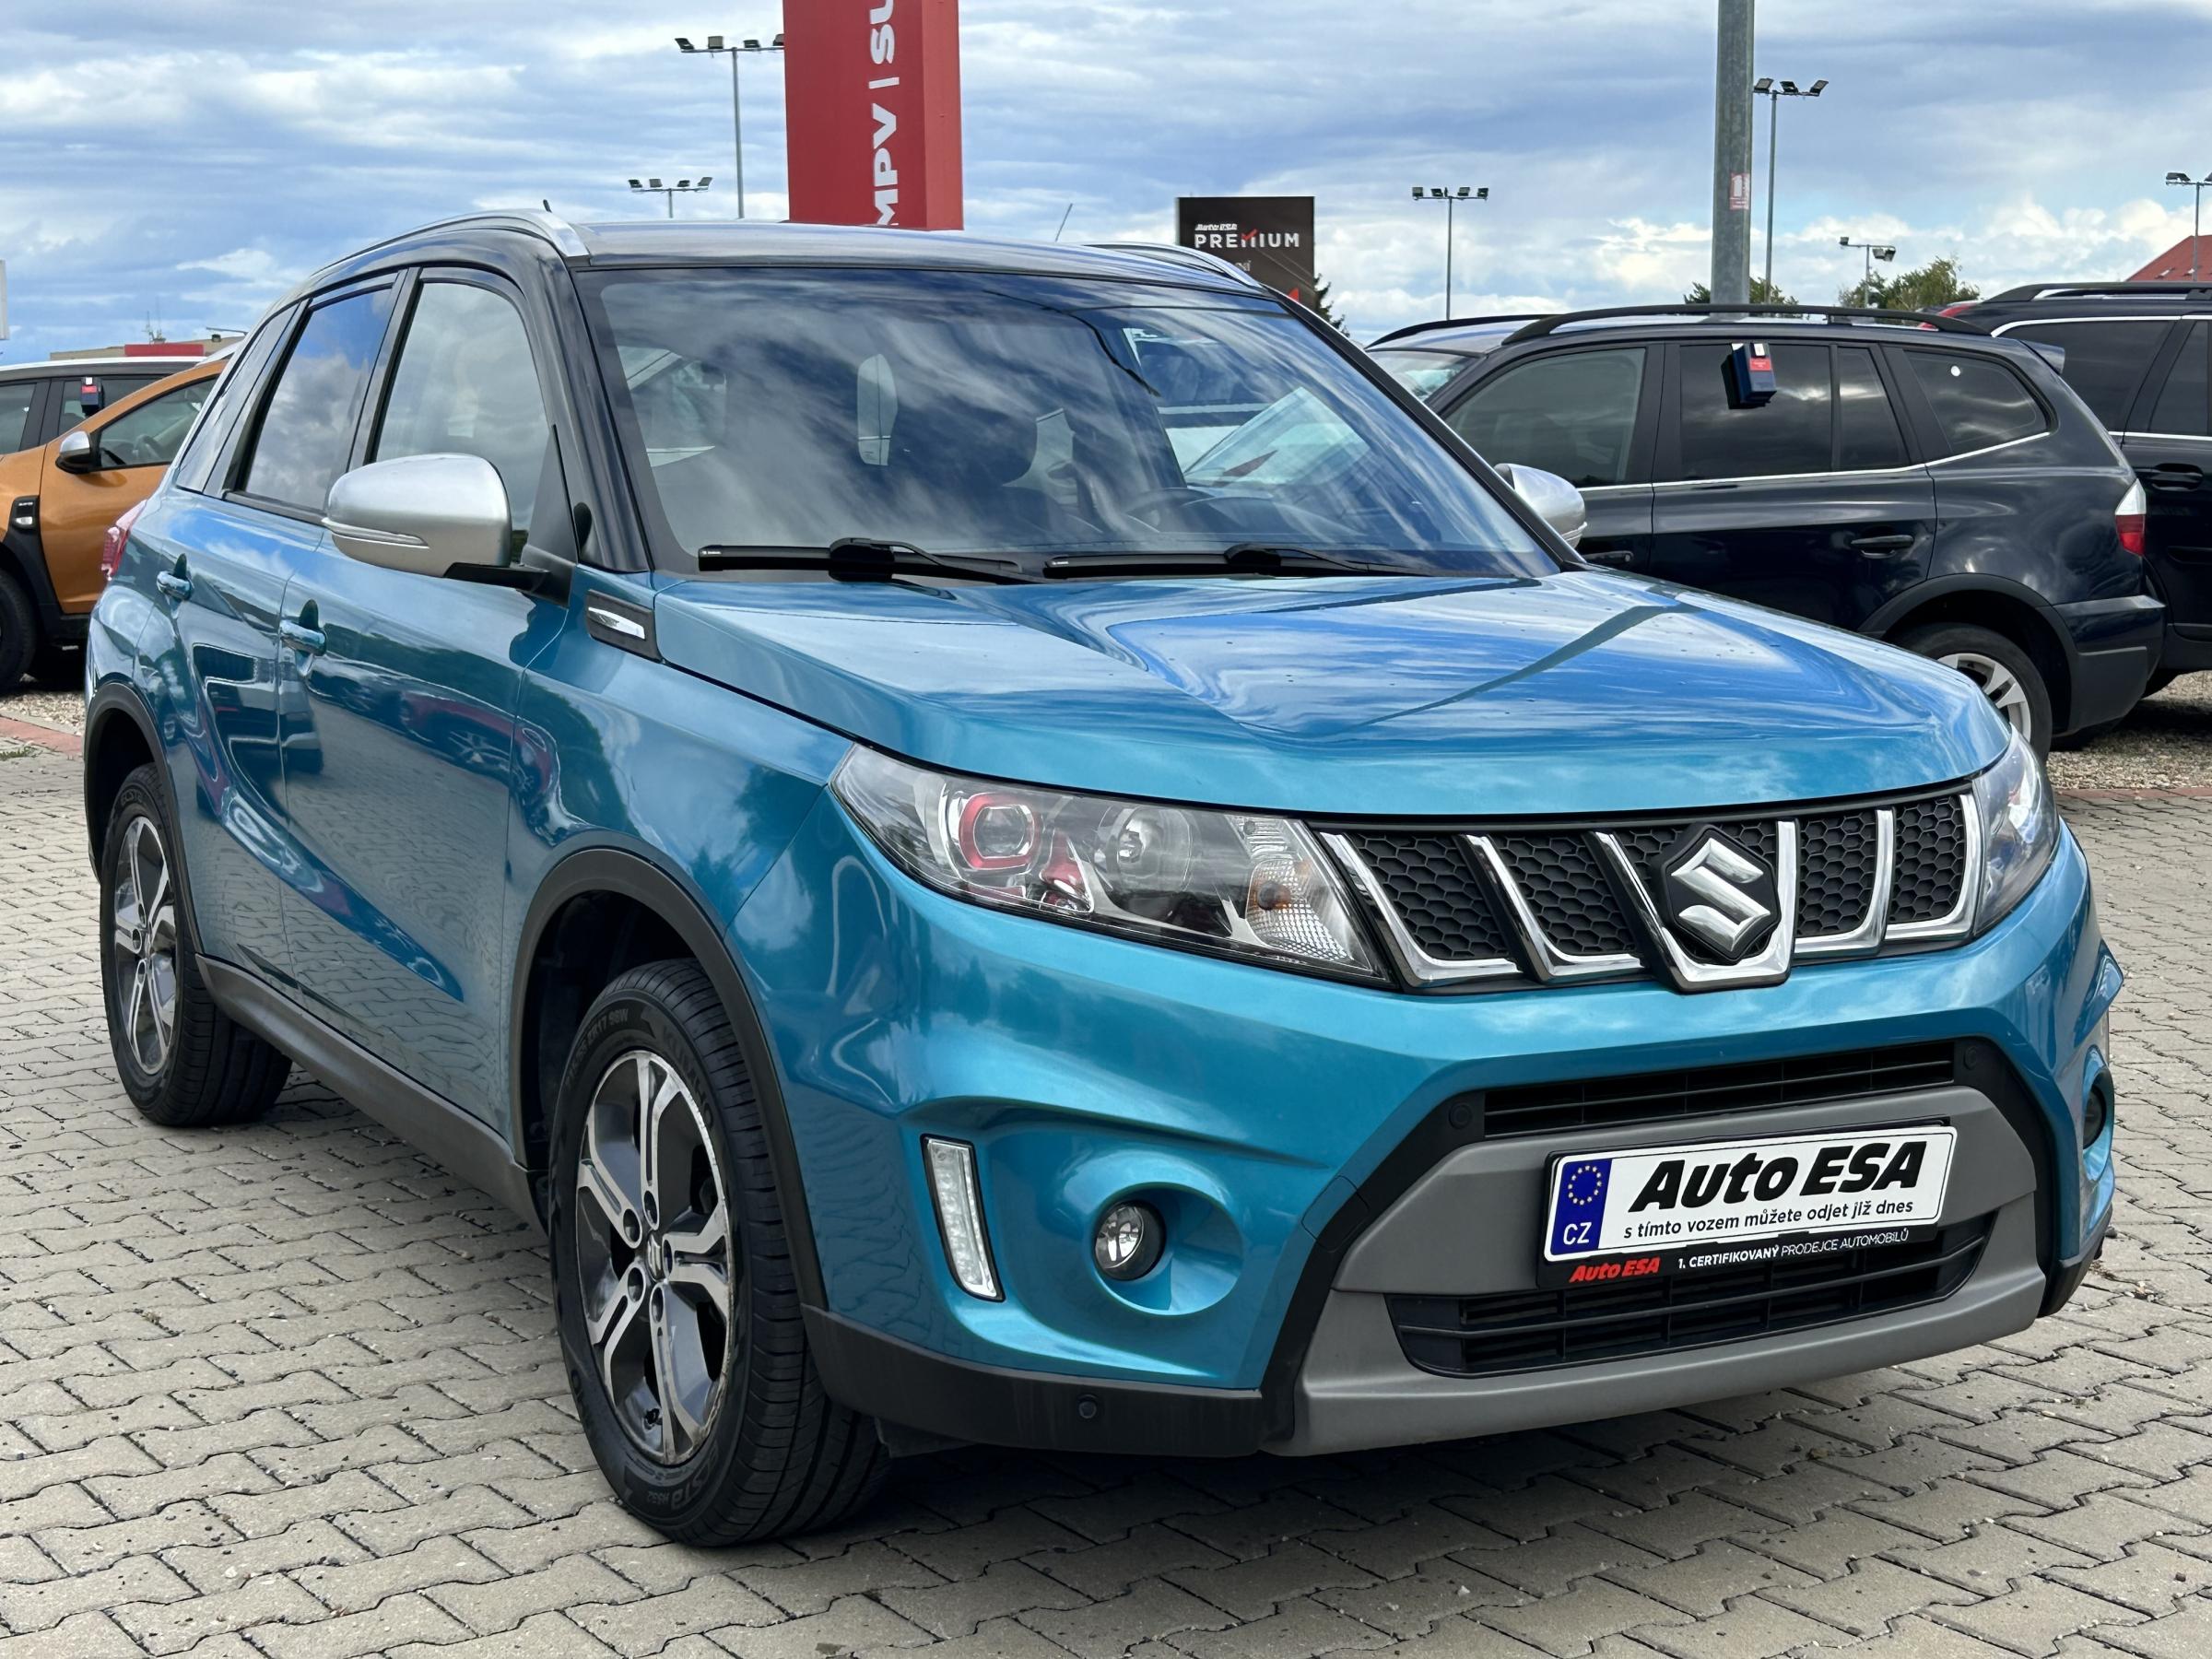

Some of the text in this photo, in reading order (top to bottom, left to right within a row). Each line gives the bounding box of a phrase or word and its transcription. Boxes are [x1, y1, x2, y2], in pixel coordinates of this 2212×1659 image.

[872, 102, 899, 225] MPV
[1628, 1141, 1928, 1213] Auto ESA
[1563, 1222, 1593, 1245] CZ
[1624, 1227, 1632, 1239] s
[1638, 1221, 1681, 1238] tímto
[1688, 1217, 1739, 1233] vozem
[1745, 1208, 1803, 1227] můžete
[1806, 1202, 1848, 1222] odjet
[1876, 1199, 1913, 1215] dnes
[1569, 1257, 1661, 1283] Auto ESA
[1677, 1258, 1687, 1269] 1.
[1688, 1244, 1780, 1267] CERTIFIKOVANÝ
[1781, 1239, 1840, 1257] PRODEJCE
